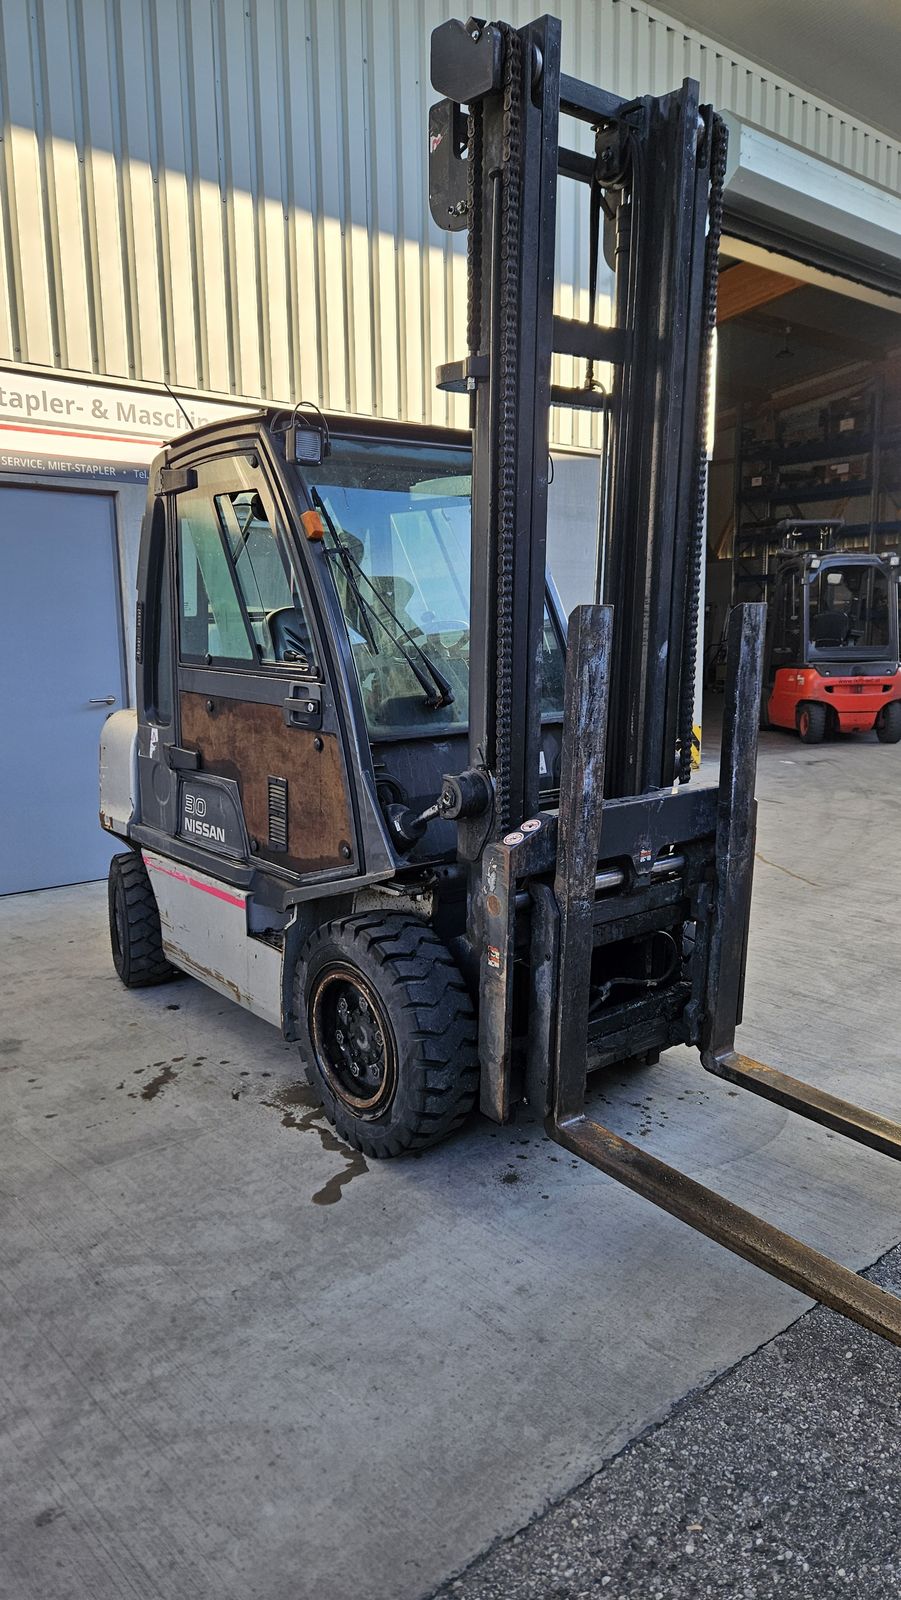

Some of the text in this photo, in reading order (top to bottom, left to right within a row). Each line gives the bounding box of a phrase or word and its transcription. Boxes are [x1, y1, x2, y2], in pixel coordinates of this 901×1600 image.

[91, 398, 109, 420] &
[1, 456, 46, 470] SERVICE,
[48, 460, 117, 476] MIET-STAPLER
[185, 794, 207, 817] 30
[185, 817, 225, 842] NISSAN
